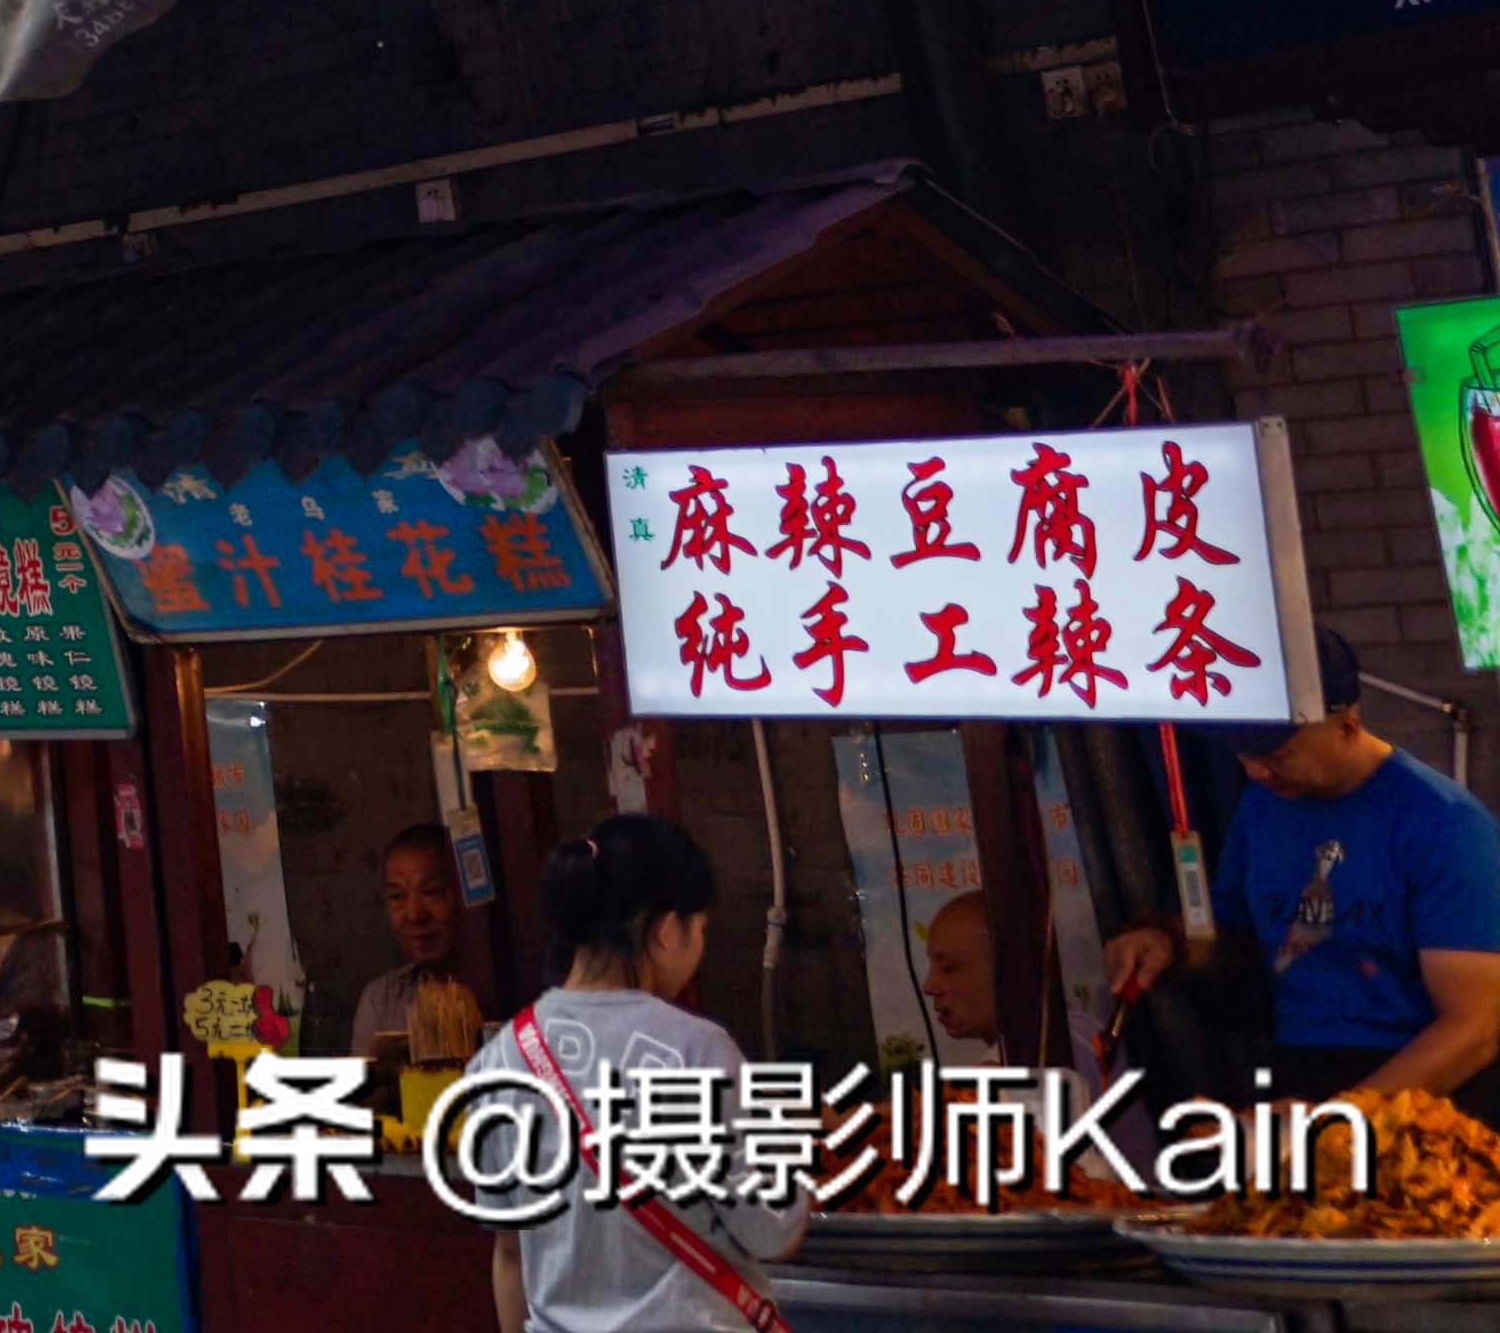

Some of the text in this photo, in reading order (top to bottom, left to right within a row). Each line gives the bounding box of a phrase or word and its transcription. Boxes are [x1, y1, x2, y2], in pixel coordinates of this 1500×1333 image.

[134, 511, 573, 613] 蜜汁桂花糕
[622, 465, 656, 542] 清真
[660, 439, 1241, 579] 麻辣豆腐皮
[673, 576, 1262, 709] 纯手工辣条
